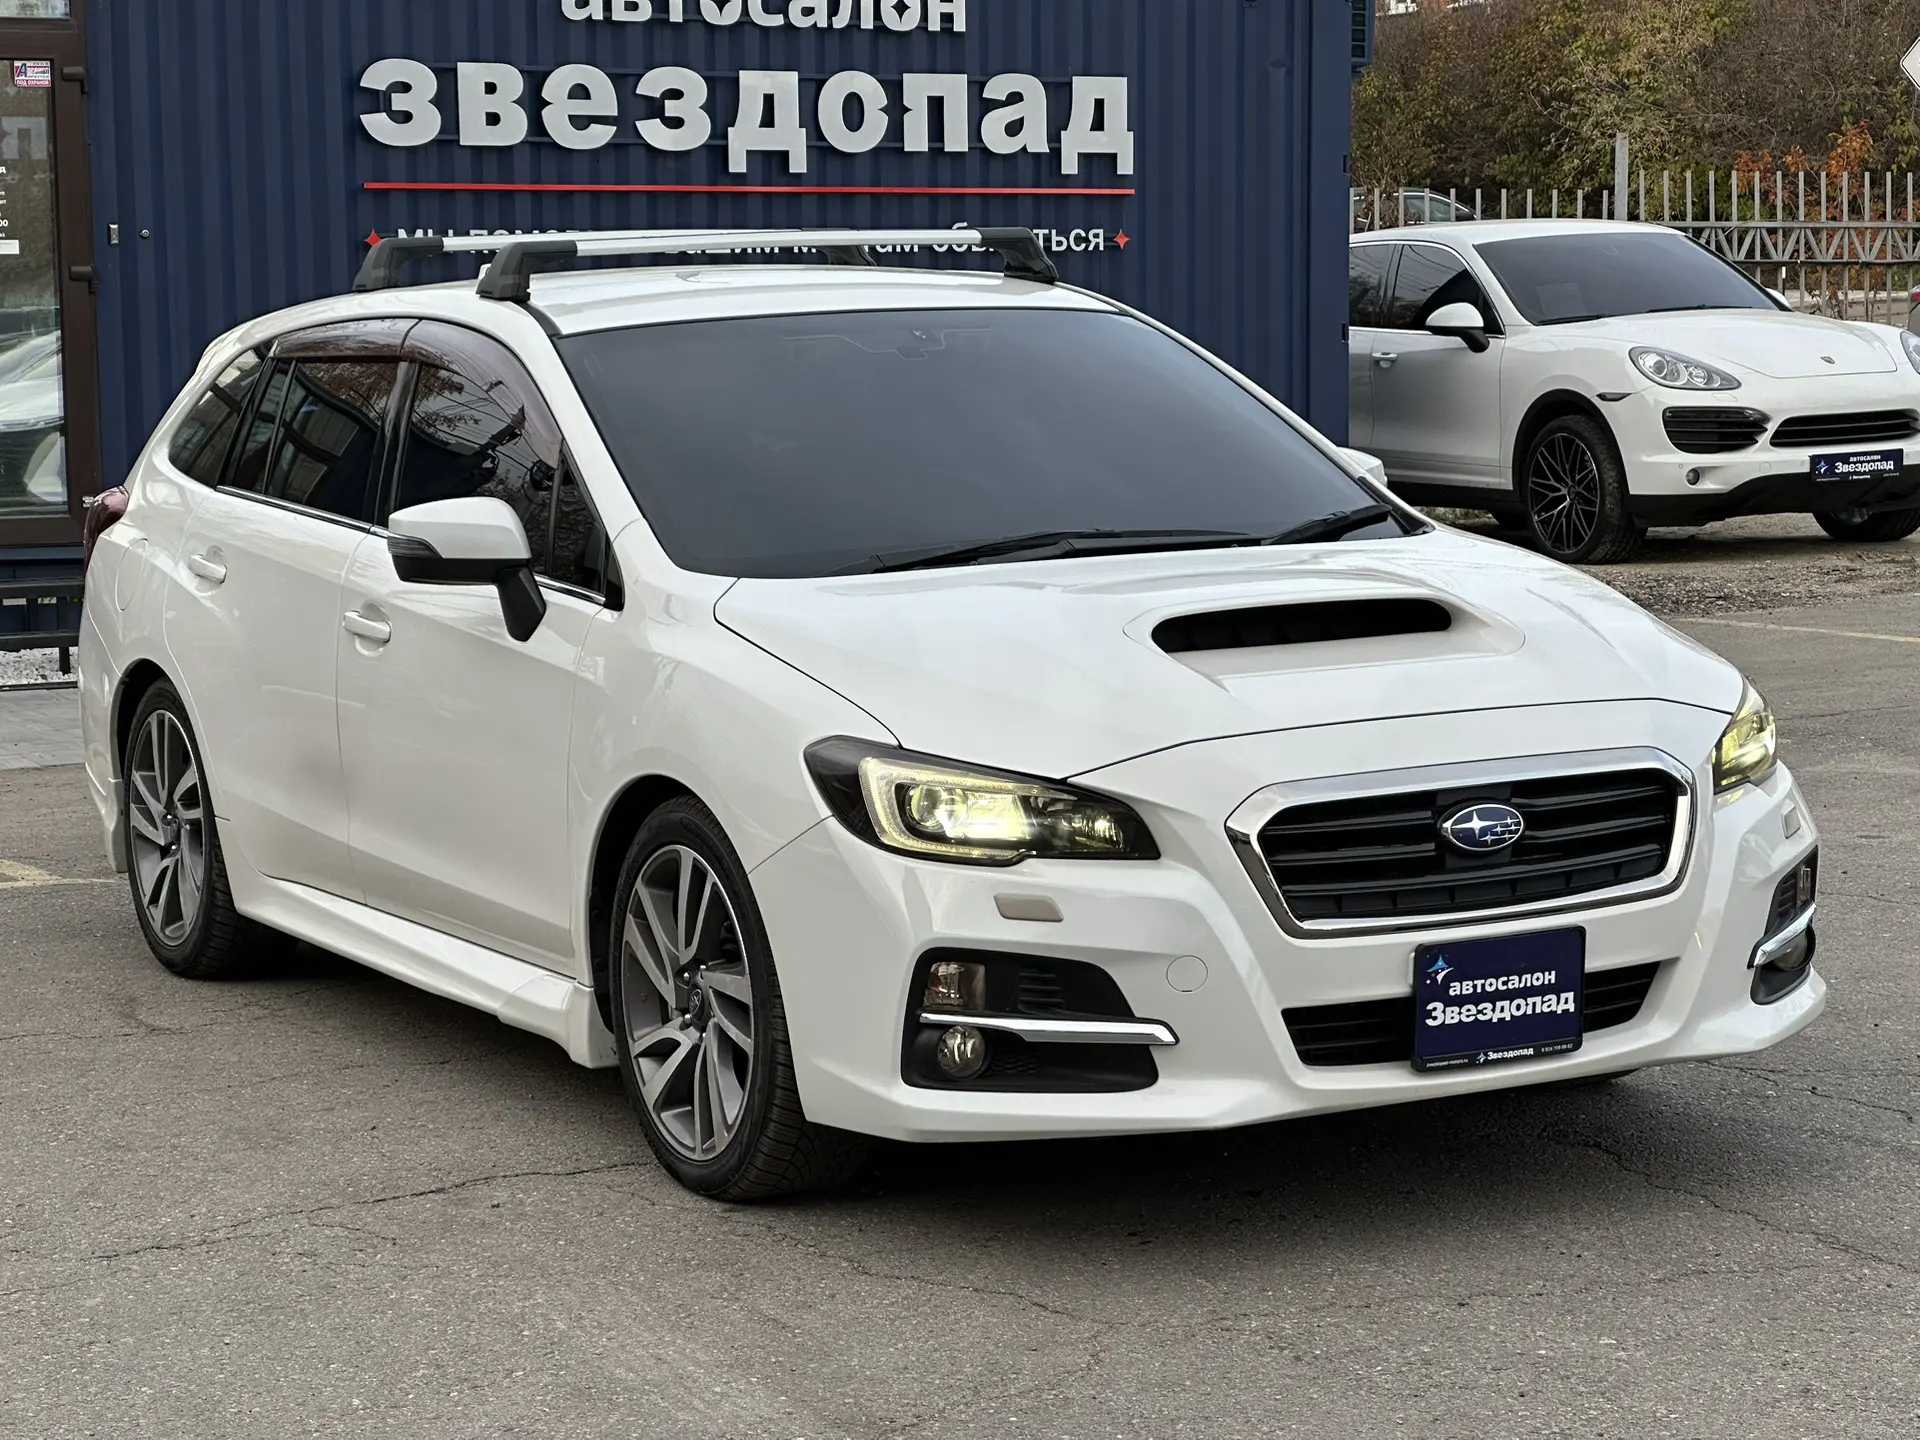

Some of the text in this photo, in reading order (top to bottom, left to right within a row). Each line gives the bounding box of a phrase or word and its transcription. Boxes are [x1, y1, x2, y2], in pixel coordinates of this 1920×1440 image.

[1834, 460, 1894, 473] Звездопад
[1449, 970, 1556, 996] автосалон
[1425, 991, 1575, 1027] Звездопад
[1487, 1047, 1534, 1060] Звездопад
